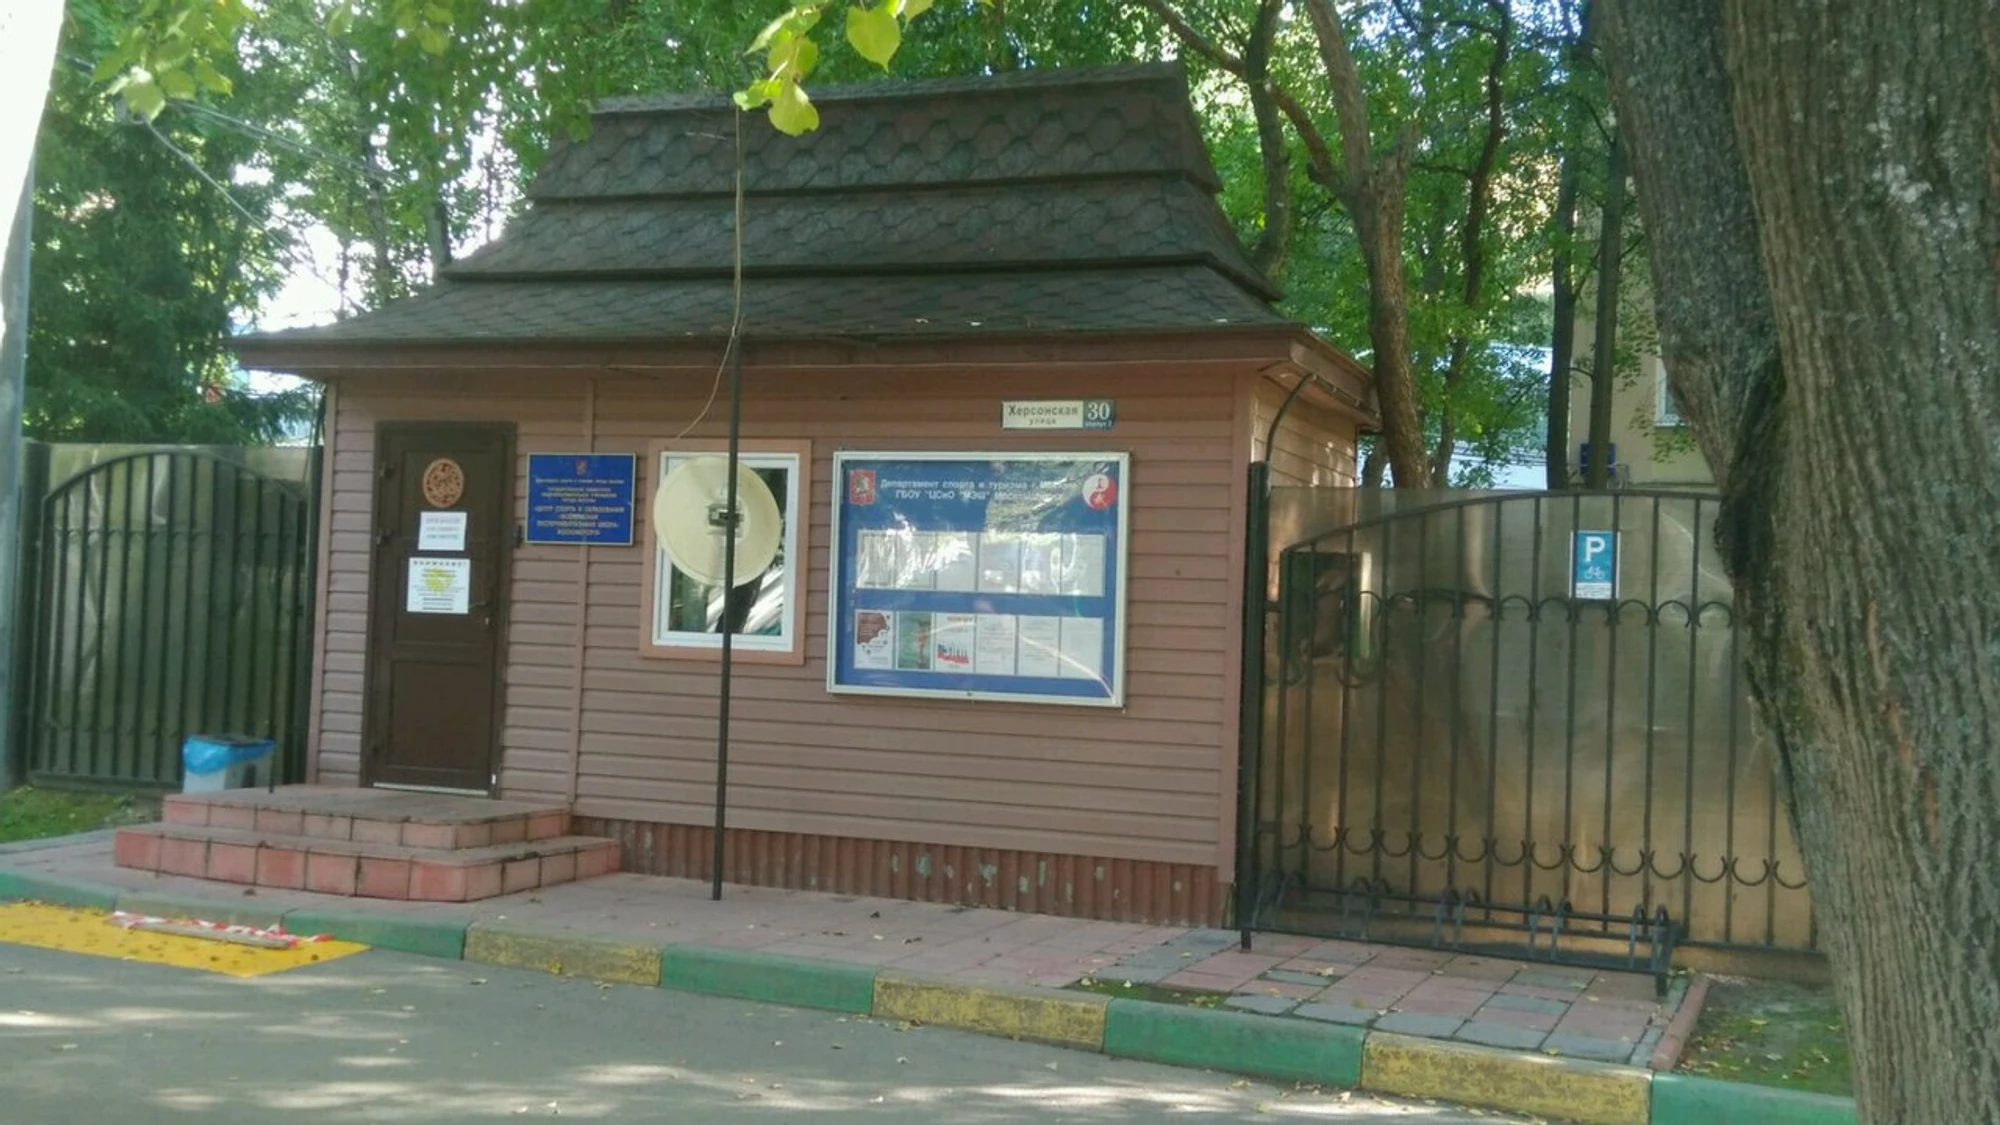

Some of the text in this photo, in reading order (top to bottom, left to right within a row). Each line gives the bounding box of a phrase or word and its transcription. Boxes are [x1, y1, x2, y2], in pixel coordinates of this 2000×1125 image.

[1008, 405, 1078, 417] Херсонская
[1087, 401, 1111, 420] 30
[1029, 418, 1057, 426] улица
[895, 489, 920, 499] ГБОУ
[1585, 536, 1606, 562] P
